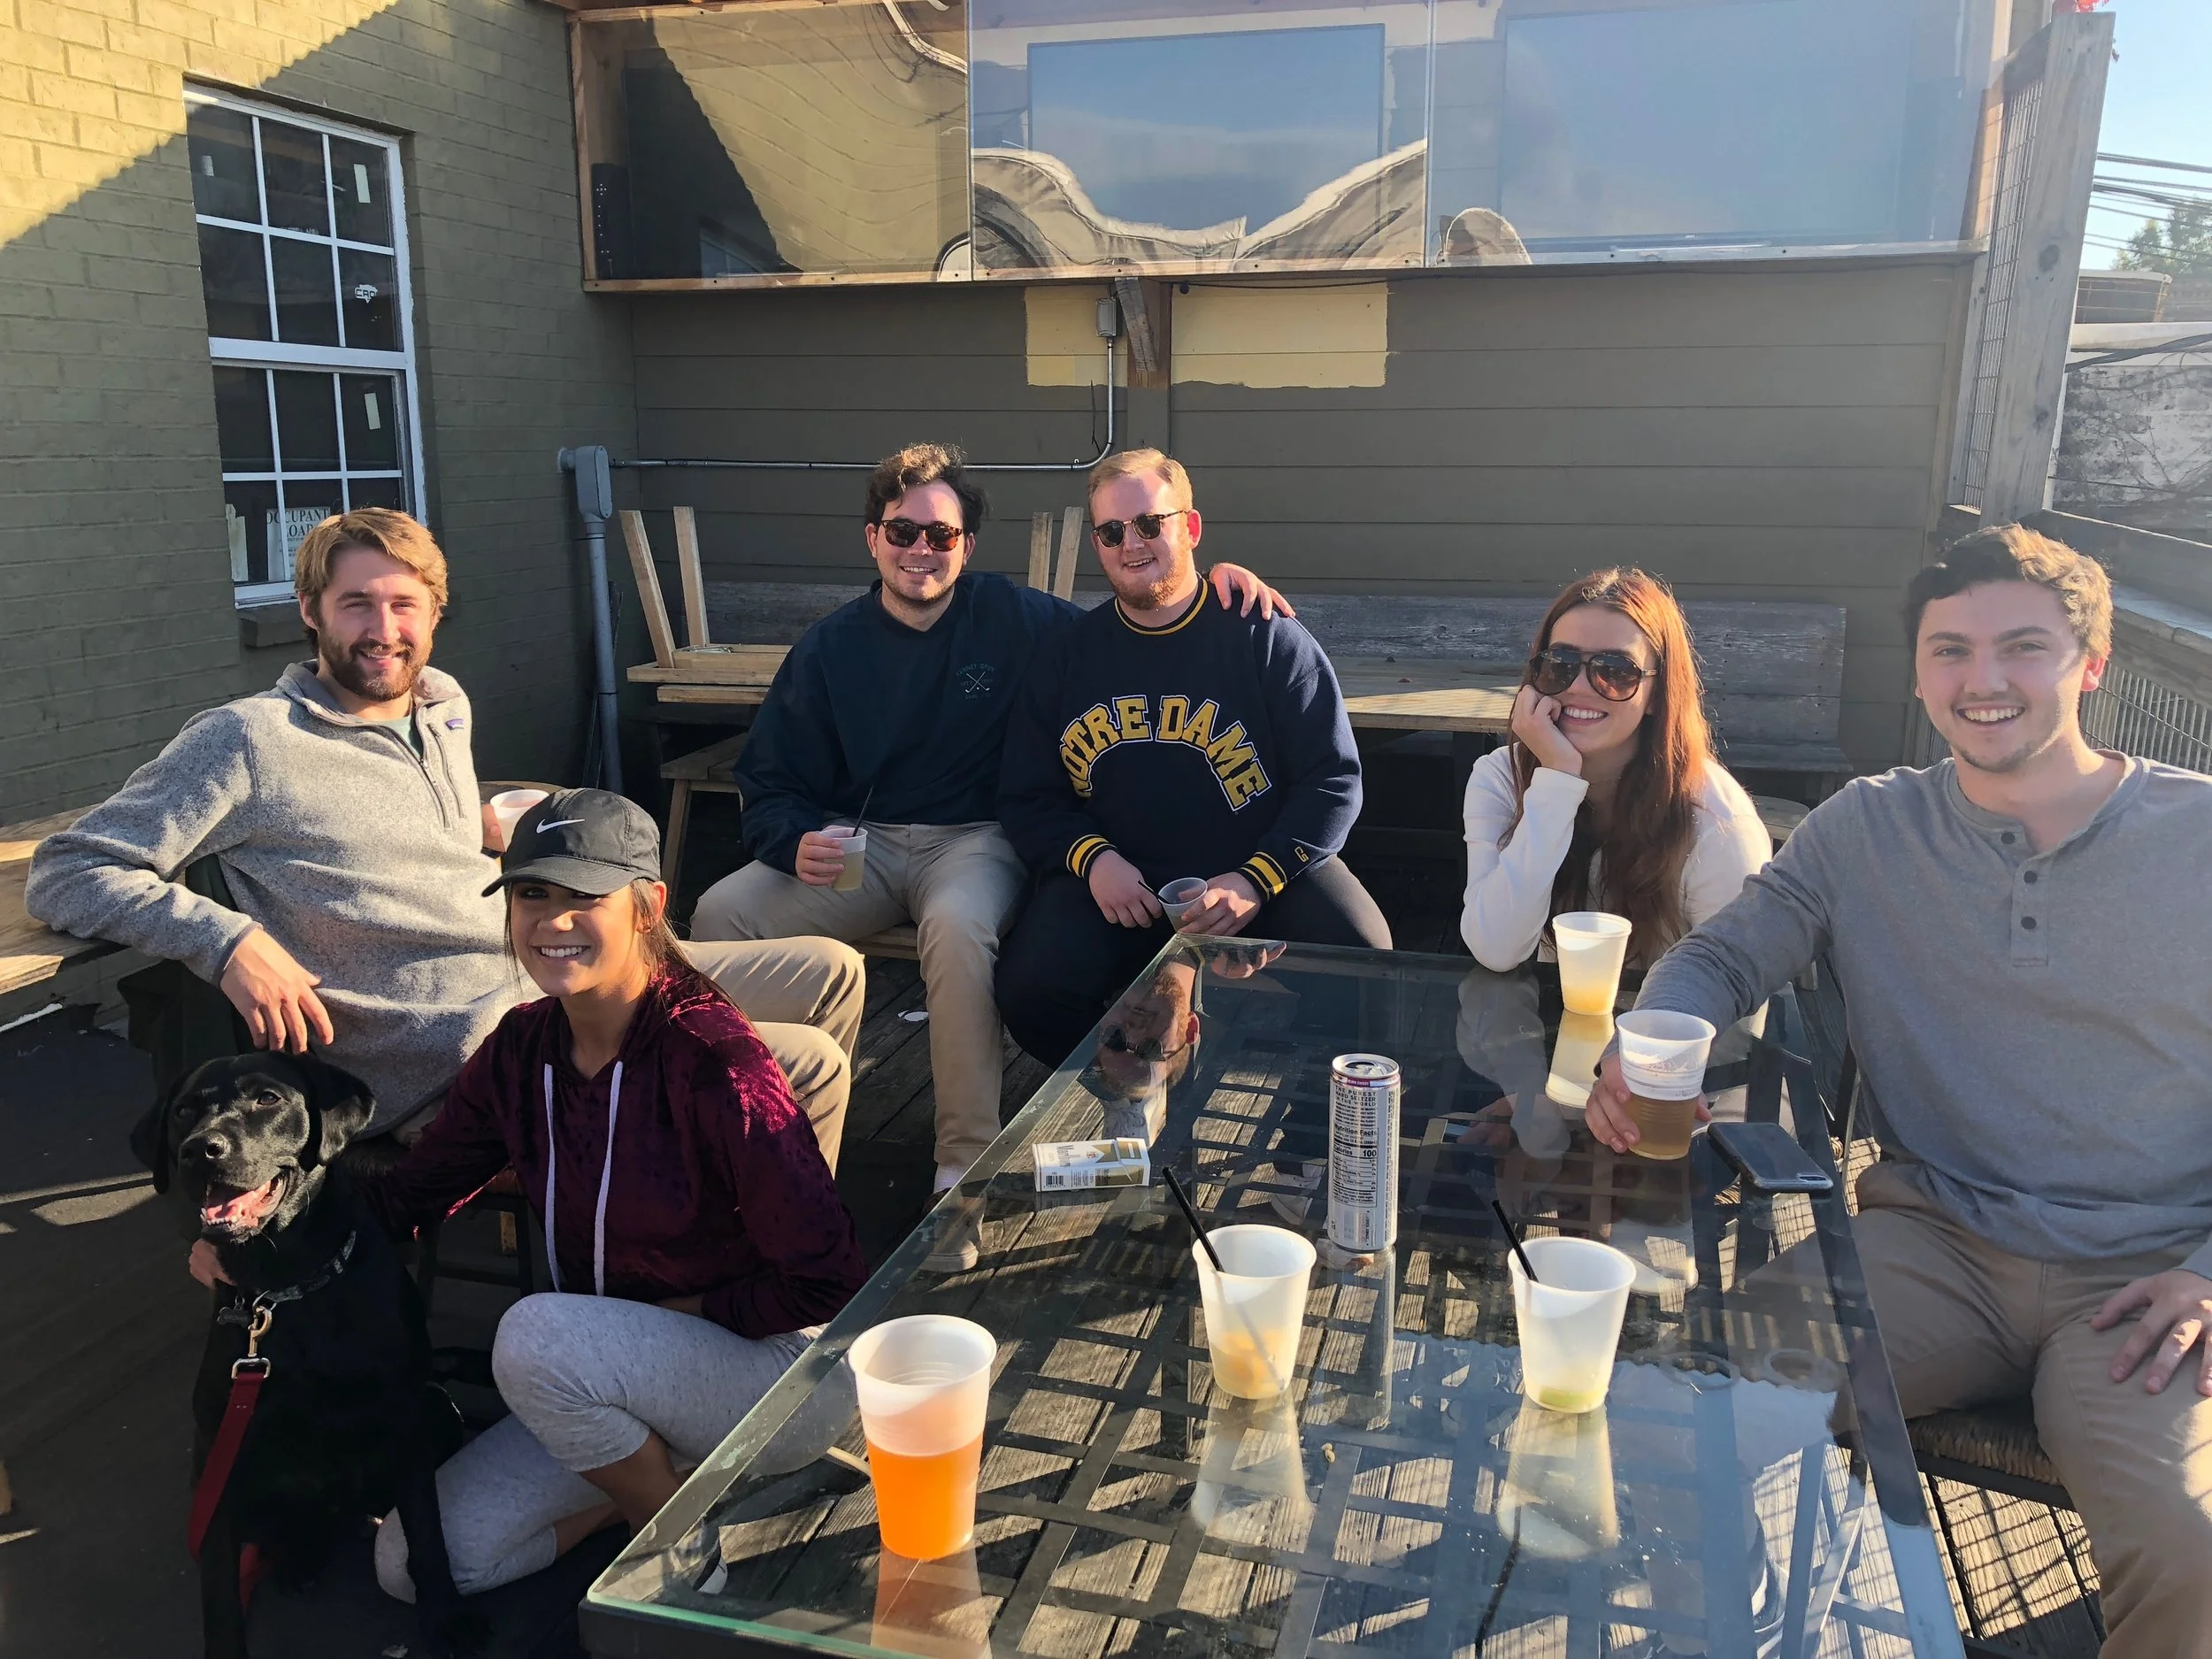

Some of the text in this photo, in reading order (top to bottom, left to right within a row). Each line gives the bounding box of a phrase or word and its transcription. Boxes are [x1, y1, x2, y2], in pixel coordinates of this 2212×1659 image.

[287, 524, 314, 537] OAD
[1155, 695, 1271, 811] DAME
[1334, 1123, 1358, 1134] Nutrition
[1334, 1144, 1353, 1156] Calories
